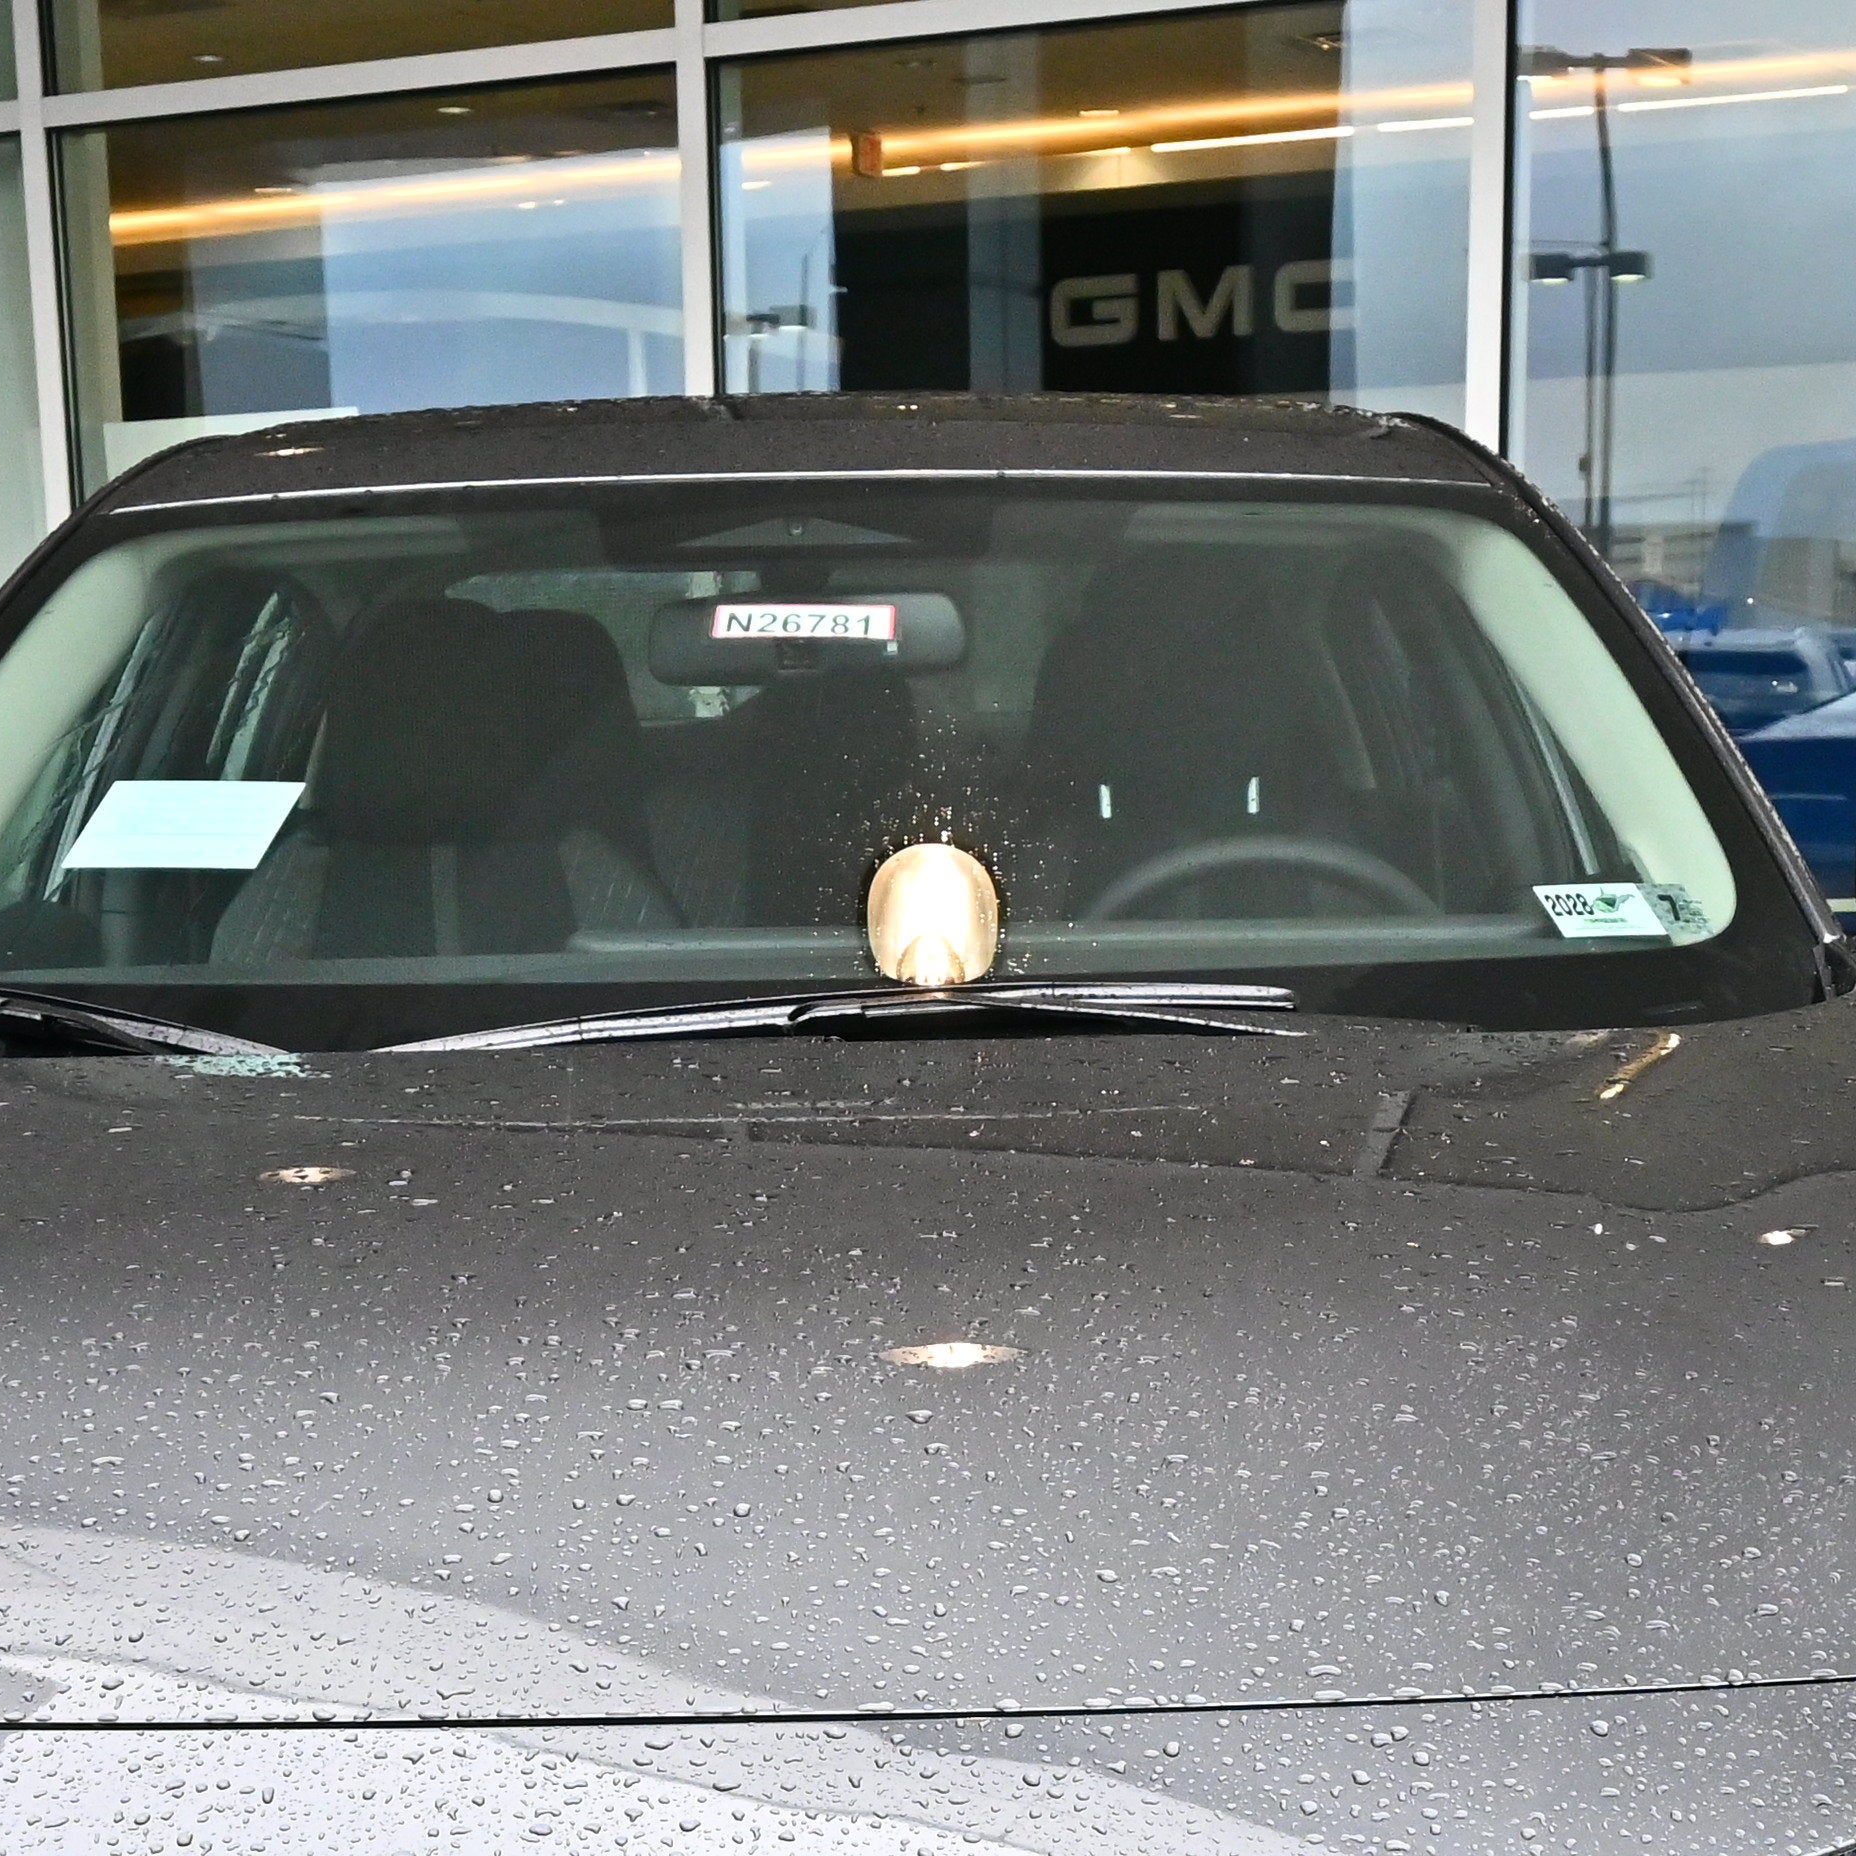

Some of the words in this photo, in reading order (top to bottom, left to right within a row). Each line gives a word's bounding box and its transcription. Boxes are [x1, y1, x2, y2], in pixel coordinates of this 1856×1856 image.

[1049, 259, 1356, 347] GMC
[726, 612, 871, 636] N26781
[1544, 893, 1595, 917] 2028
